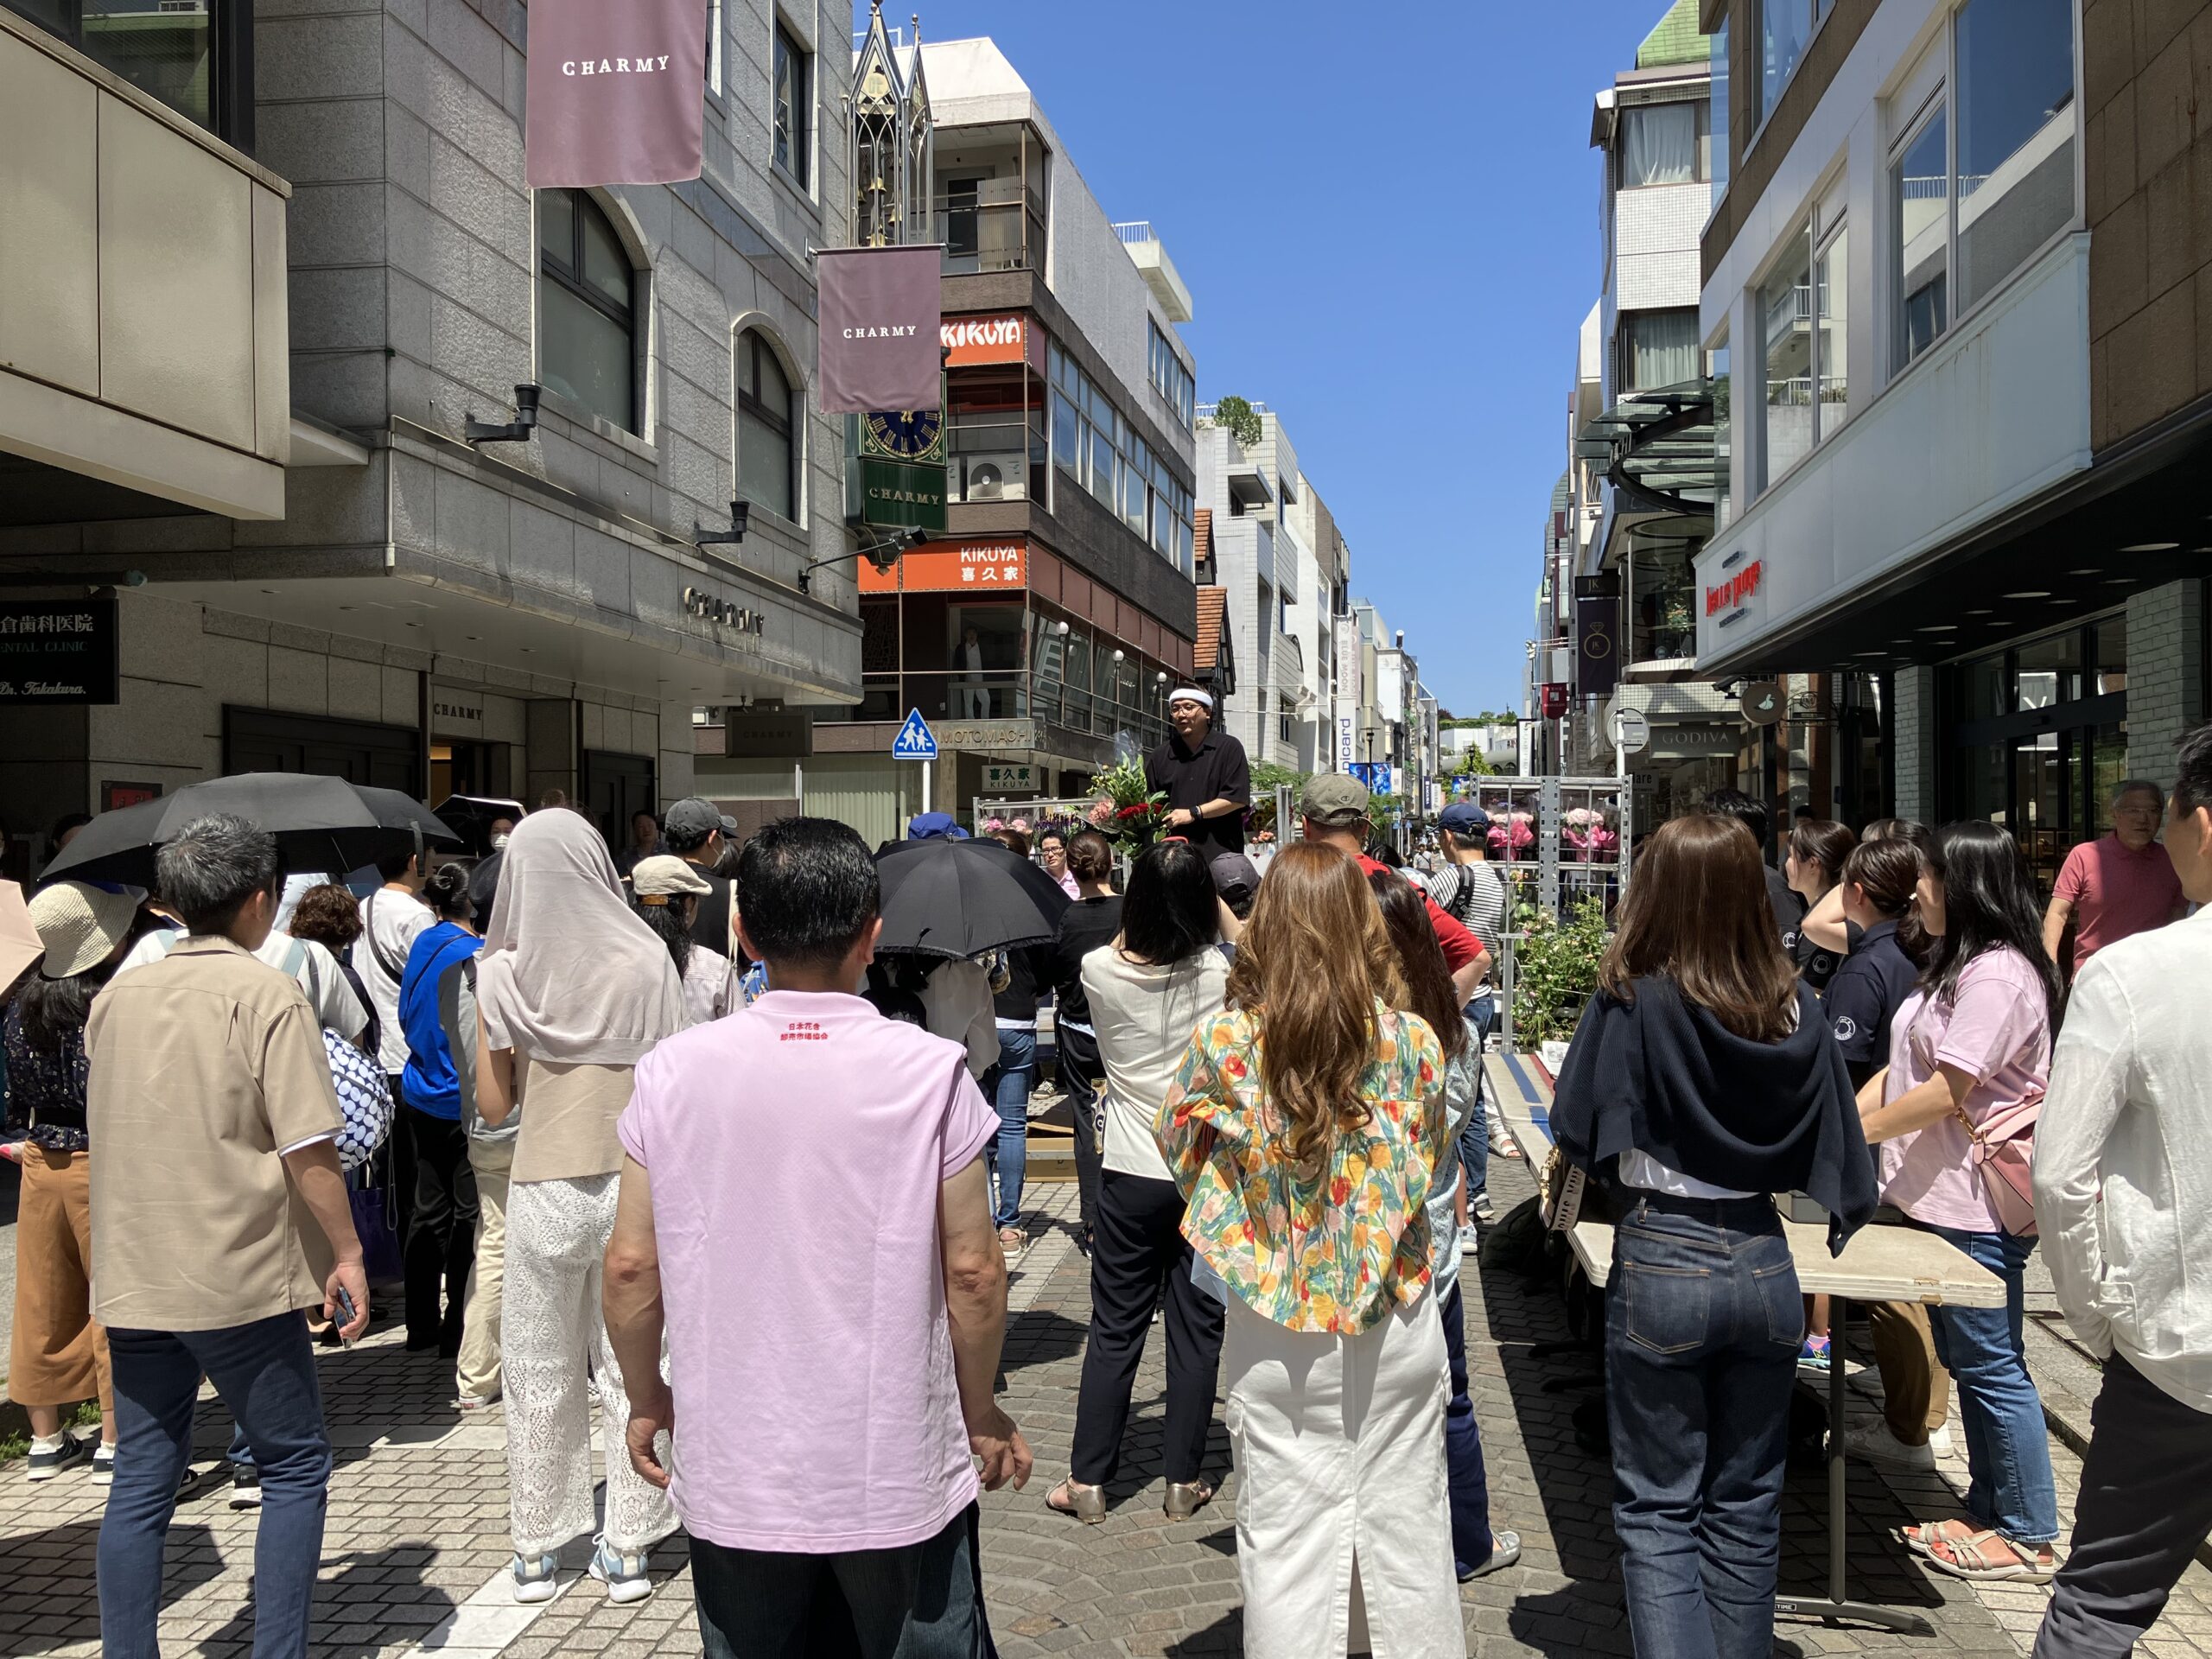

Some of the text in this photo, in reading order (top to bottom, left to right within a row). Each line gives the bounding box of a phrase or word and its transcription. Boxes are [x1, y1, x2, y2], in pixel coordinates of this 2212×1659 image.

[562, 55, 670, 76] CHARMY
[843, 326, 916, 339] CHARMY
[940, 318, 1020, 347] KIKUYA
[869, 487, 940, 505] CHARMY
[961, 546, 1019, 563] KIKUYA
[961, 566, 1019, 582] 喜久家
[0, 614, 94, 633] 倉歯科医院
[45, 641, 87, 652] CLINIC
[434, 703, 482, 721] CHARMY
[940, 728, 1032, 744] MOTOMACHI
[1662, 732, 1729, 744] GODIVA
[989, 767, 1030, 780] 喜久家
